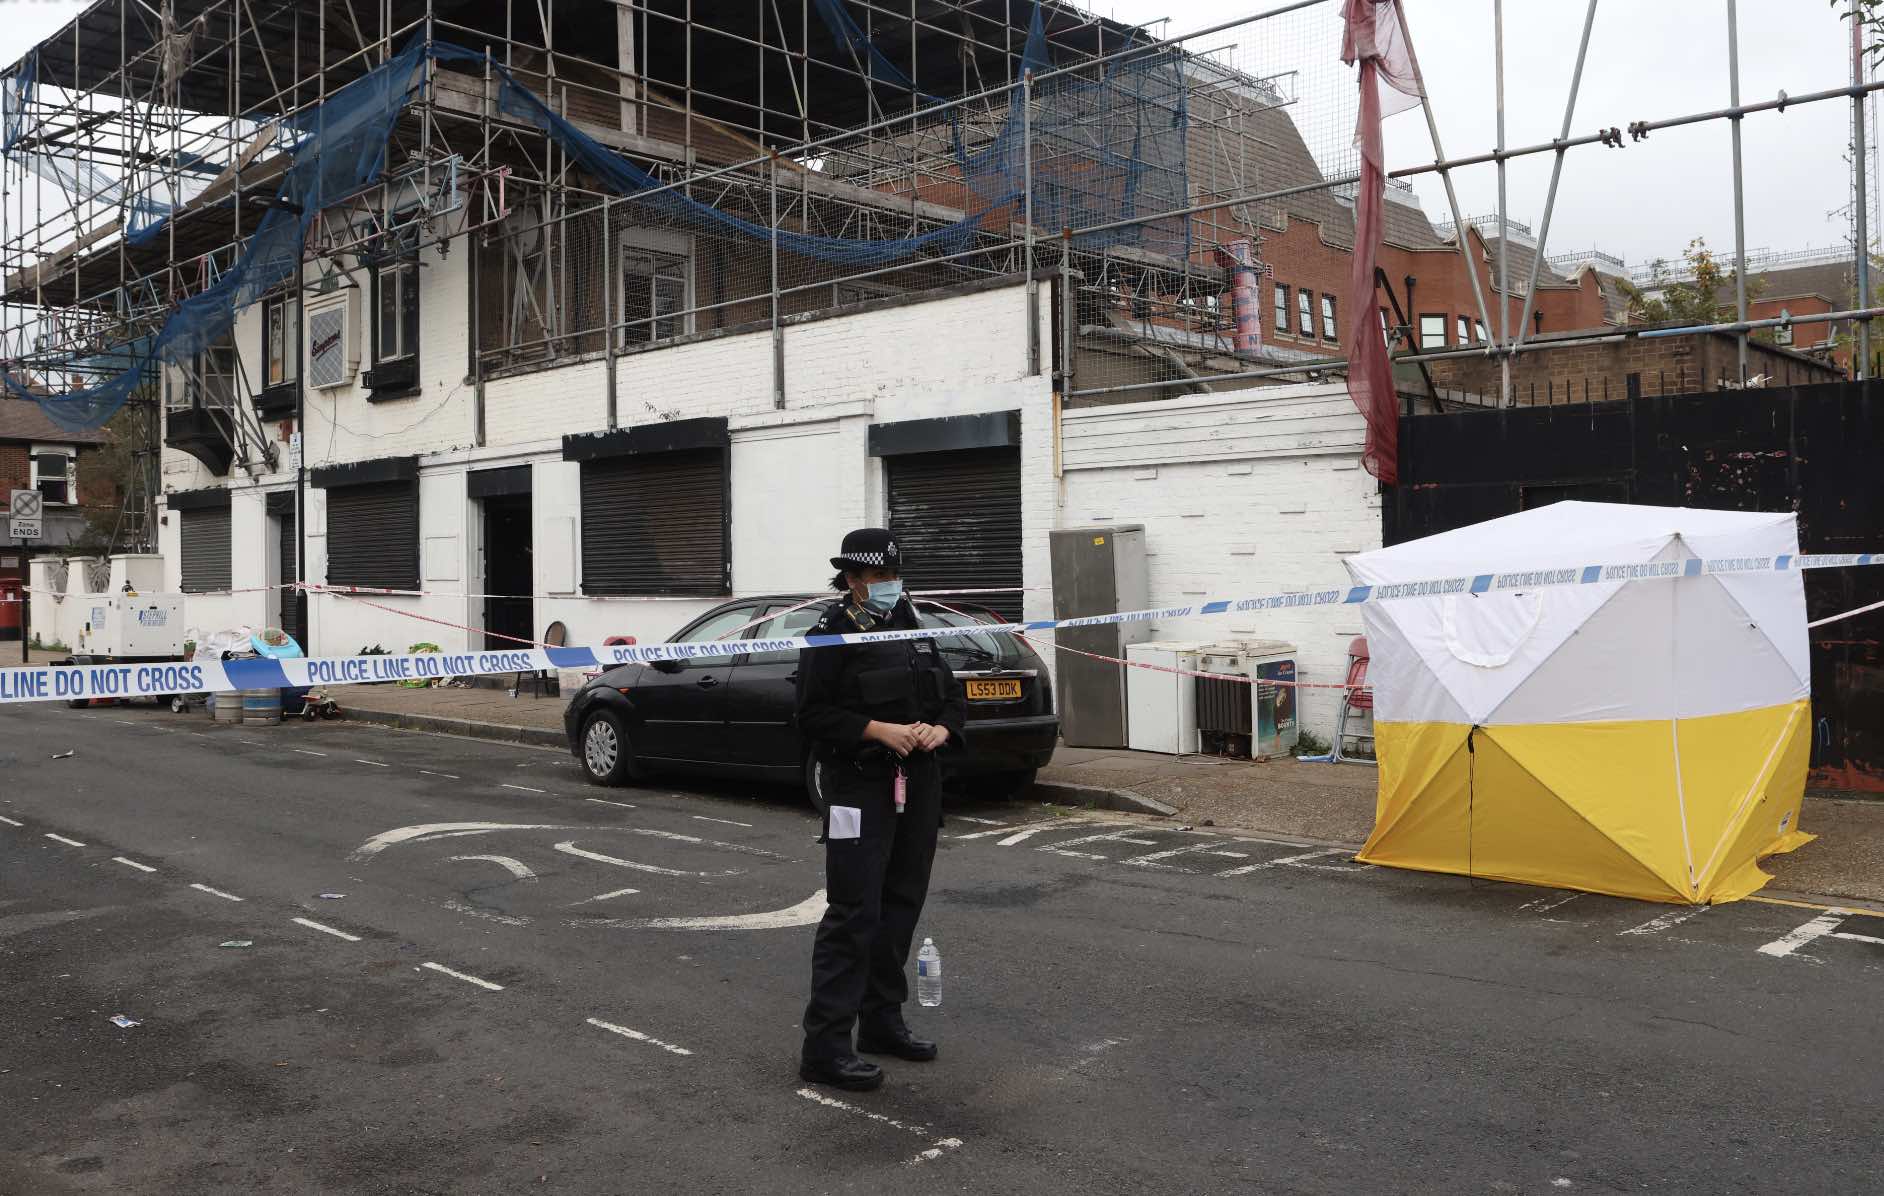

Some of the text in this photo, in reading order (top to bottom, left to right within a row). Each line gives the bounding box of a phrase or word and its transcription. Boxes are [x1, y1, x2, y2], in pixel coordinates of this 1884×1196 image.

[13, 528, 39, 536] ENDS
[307, 652, 534, 683] POLICE LINE DO NOT CROSS
[0, 665, 204, 699] LINE DO NOT CROSS
[970, 681, 997, 697] LS53
